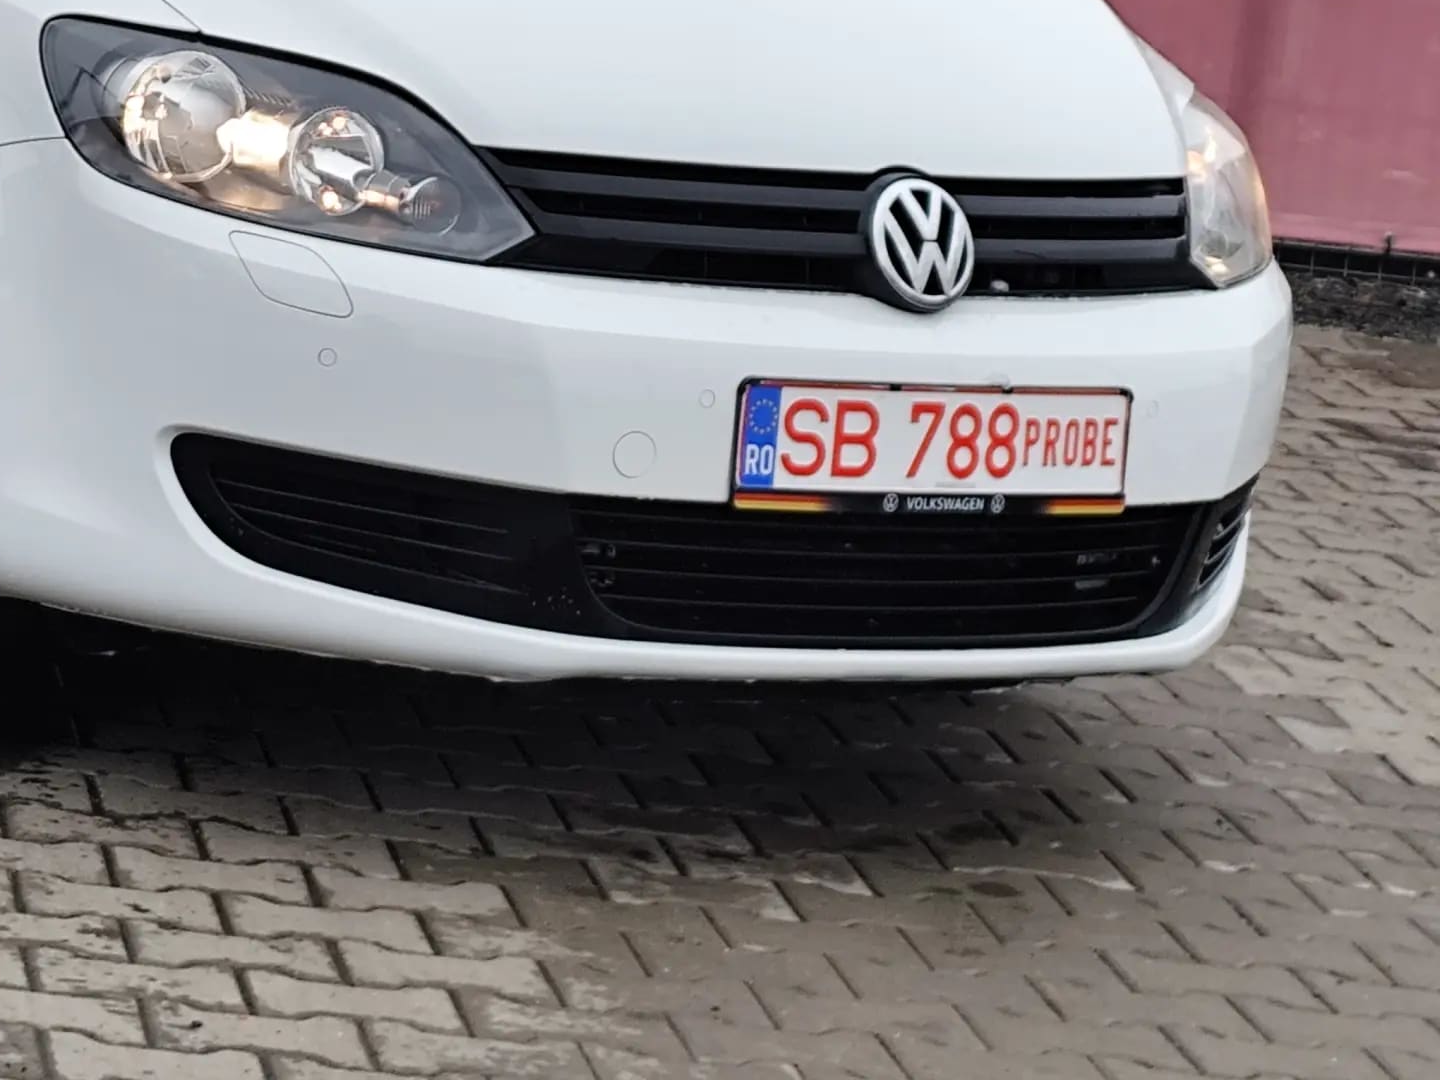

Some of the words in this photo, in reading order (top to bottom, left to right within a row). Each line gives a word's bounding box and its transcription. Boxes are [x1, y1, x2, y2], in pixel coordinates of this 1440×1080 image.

[781, 398, 880, 477] SB
[906, 401, 1020, 479] 788
[1023, 417, 1119, 467] PROBE
[744, 443, 775, 475] RO
[907, 496, 985, 511] VOLKSWAGEN
